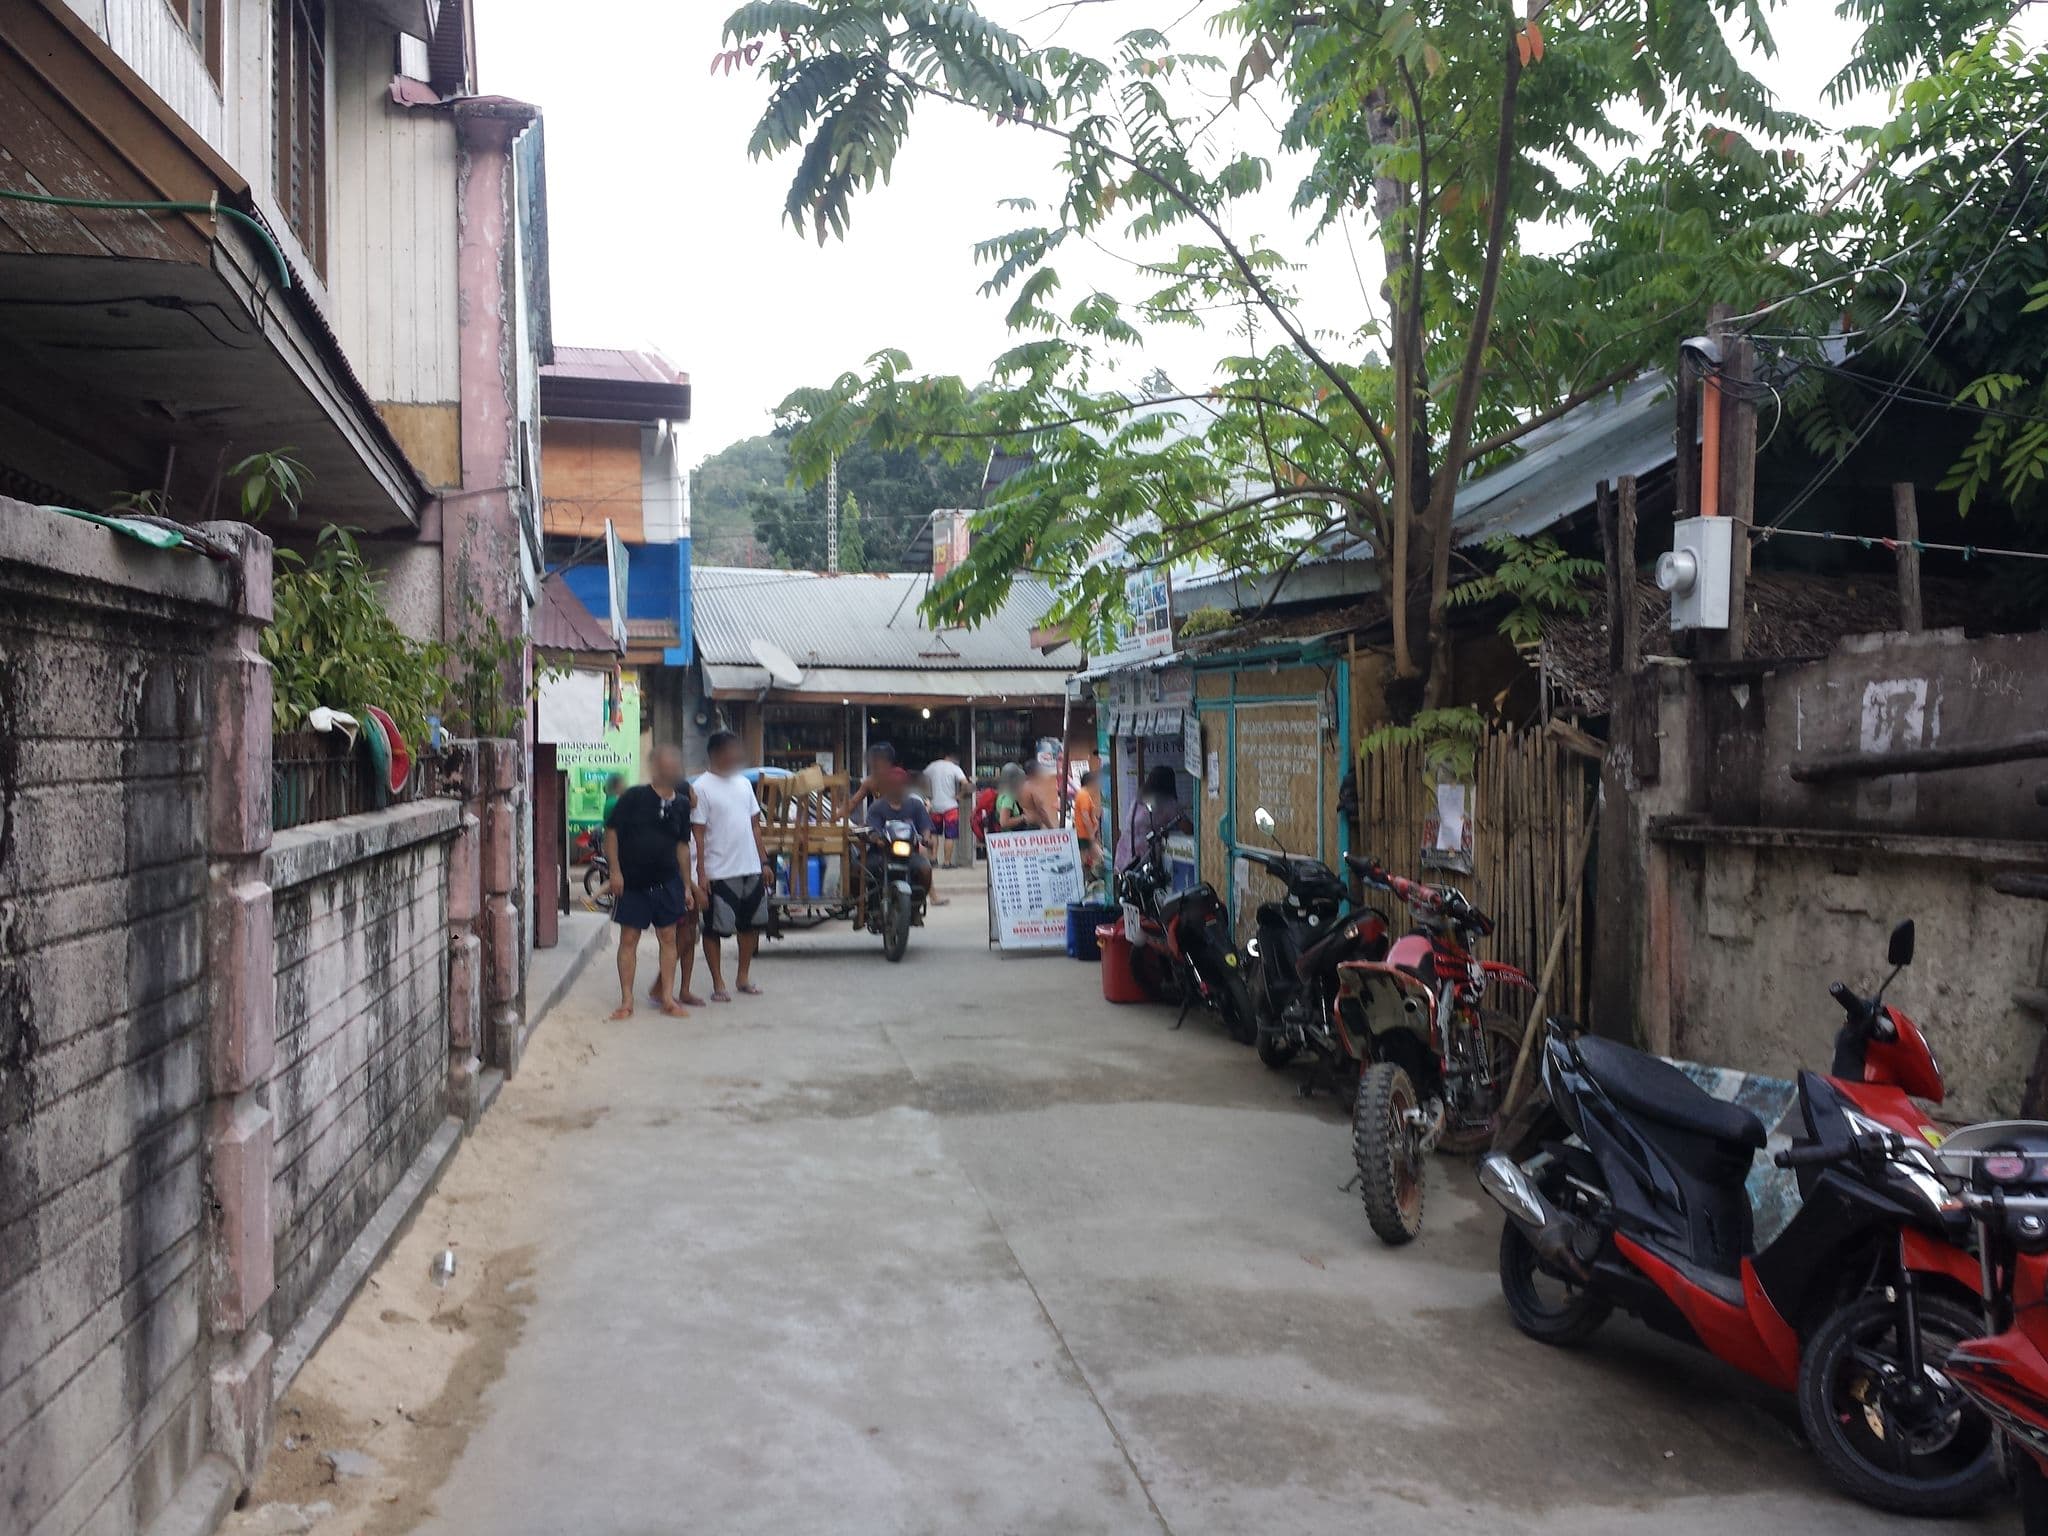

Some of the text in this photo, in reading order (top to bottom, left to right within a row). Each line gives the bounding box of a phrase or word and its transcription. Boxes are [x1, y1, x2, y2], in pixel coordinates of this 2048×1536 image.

[991, 833, 1070, 849] VAN TO PUERTO
[1012, 924, 1066, 935] BOOK NOW
